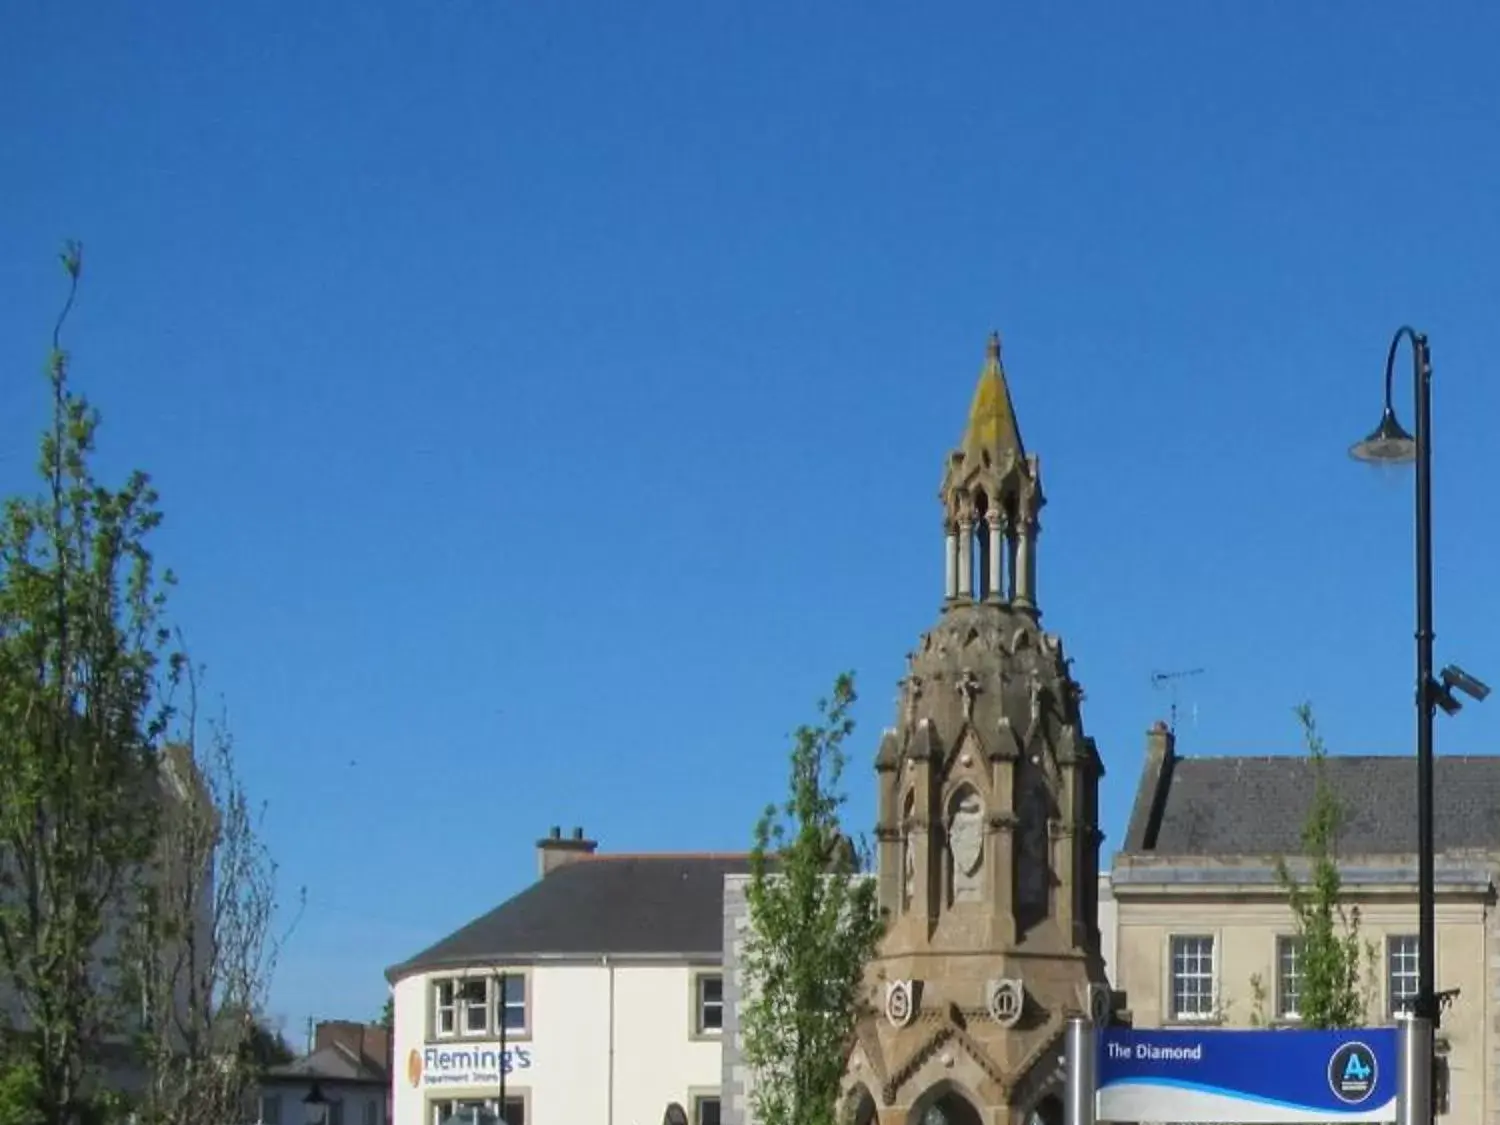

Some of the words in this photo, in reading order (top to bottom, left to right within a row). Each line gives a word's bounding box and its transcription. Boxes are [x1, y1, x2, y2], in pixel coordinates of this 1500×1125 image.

[423, 1045, 532, 1074] Fleming's
[1107, 1042, 1131, 1059] The
[1136, 1042, 1202, 1060] Diamond
